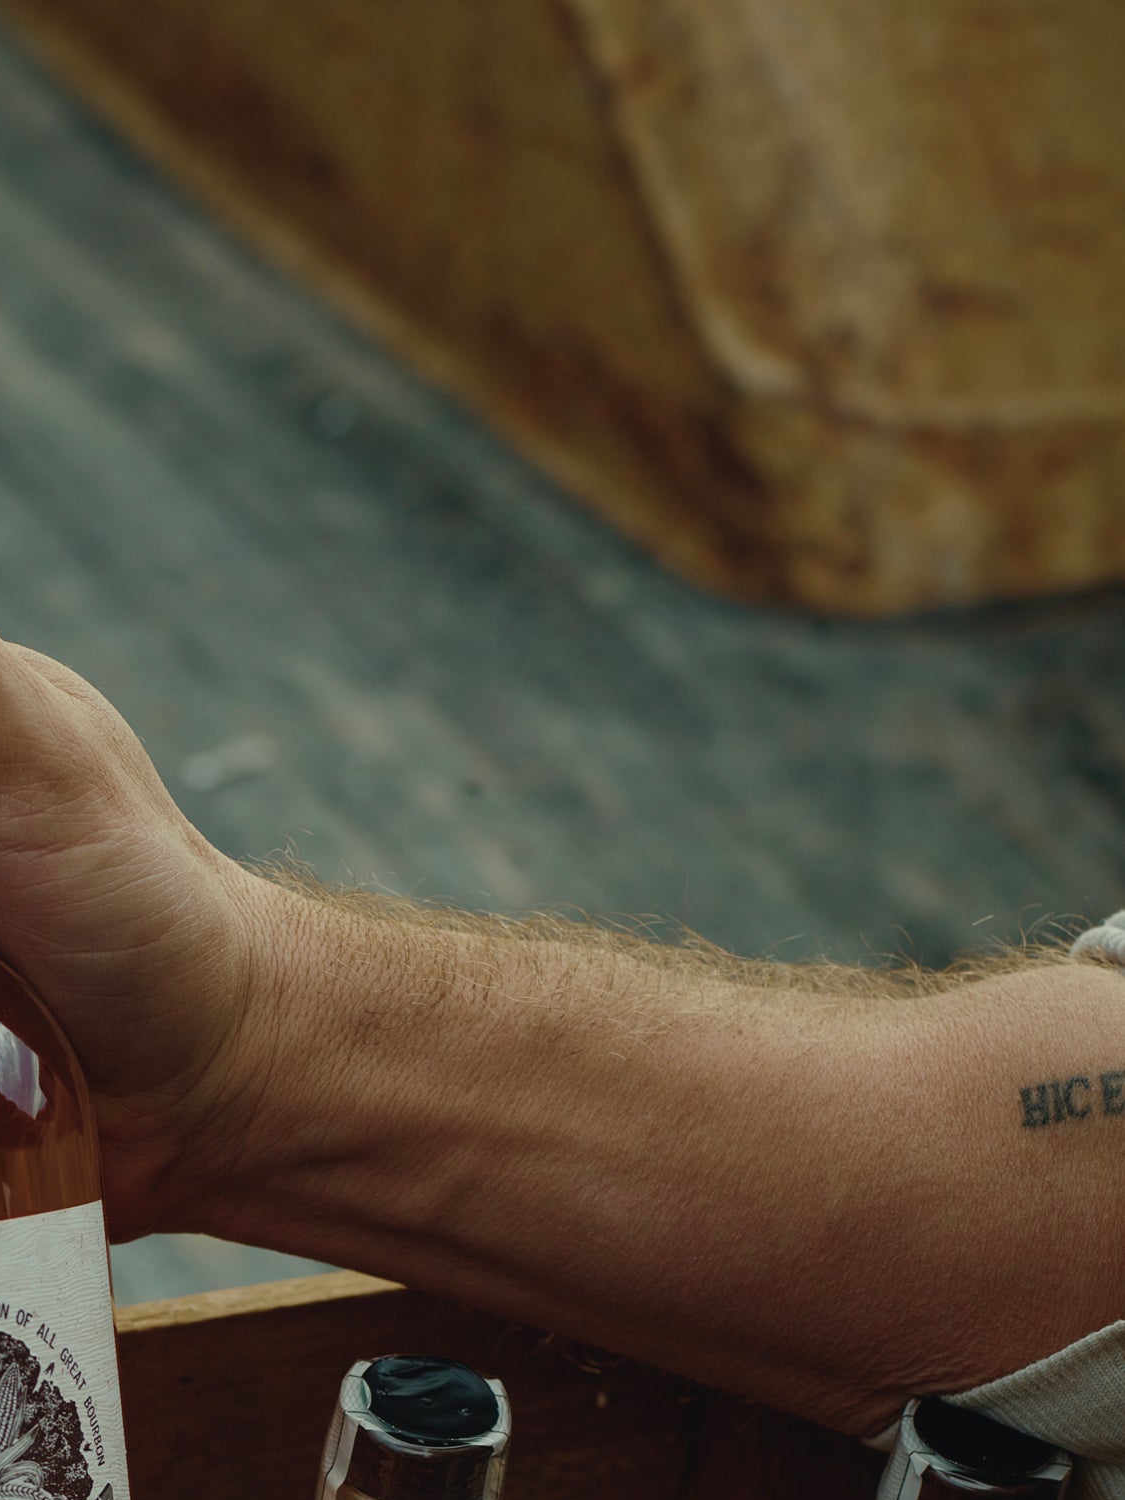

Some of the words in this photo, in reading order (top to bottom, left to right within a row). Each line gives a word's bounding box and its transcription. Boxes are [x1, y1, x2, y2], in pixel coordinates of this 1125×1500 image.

[1019, 1075, 1091, 1128] HIC
[16, 1310, 33, 1327] OF
[36, 1323, 57, 1350] ALL
[59, 1348, 88, 1391] GREAT
[82, 1395, 106, 1467] BOURBON
